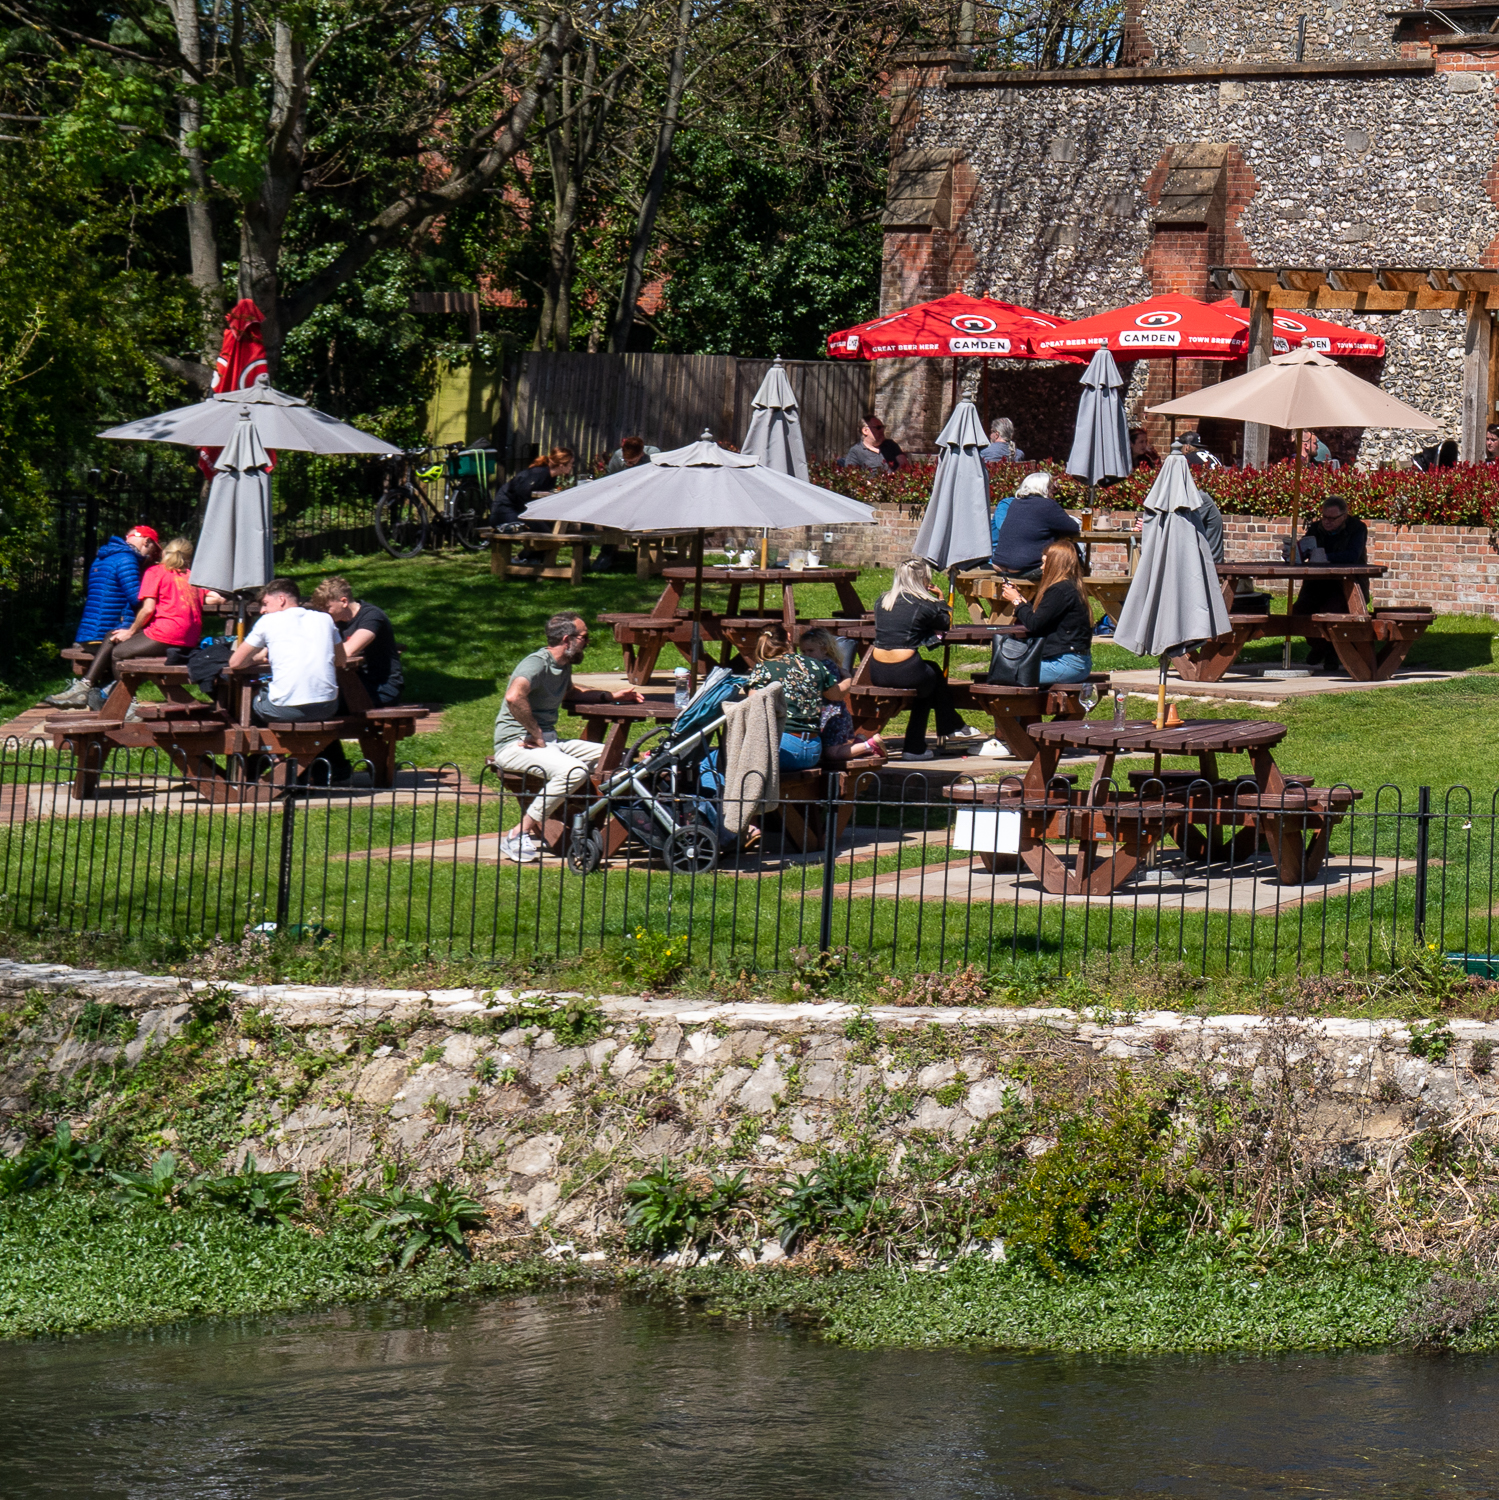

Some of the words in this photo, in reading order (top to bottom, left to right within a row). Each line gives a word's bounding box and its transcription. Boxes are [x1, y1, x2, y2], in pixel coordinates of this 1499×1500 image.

[1066, 338, 1086, 346] BEER
[1124, 333, 1176, 343] CAMDEN
[1211, 337, 1246, 346] BREWERY
[954, 341, 1006, 350] CAMDEN
